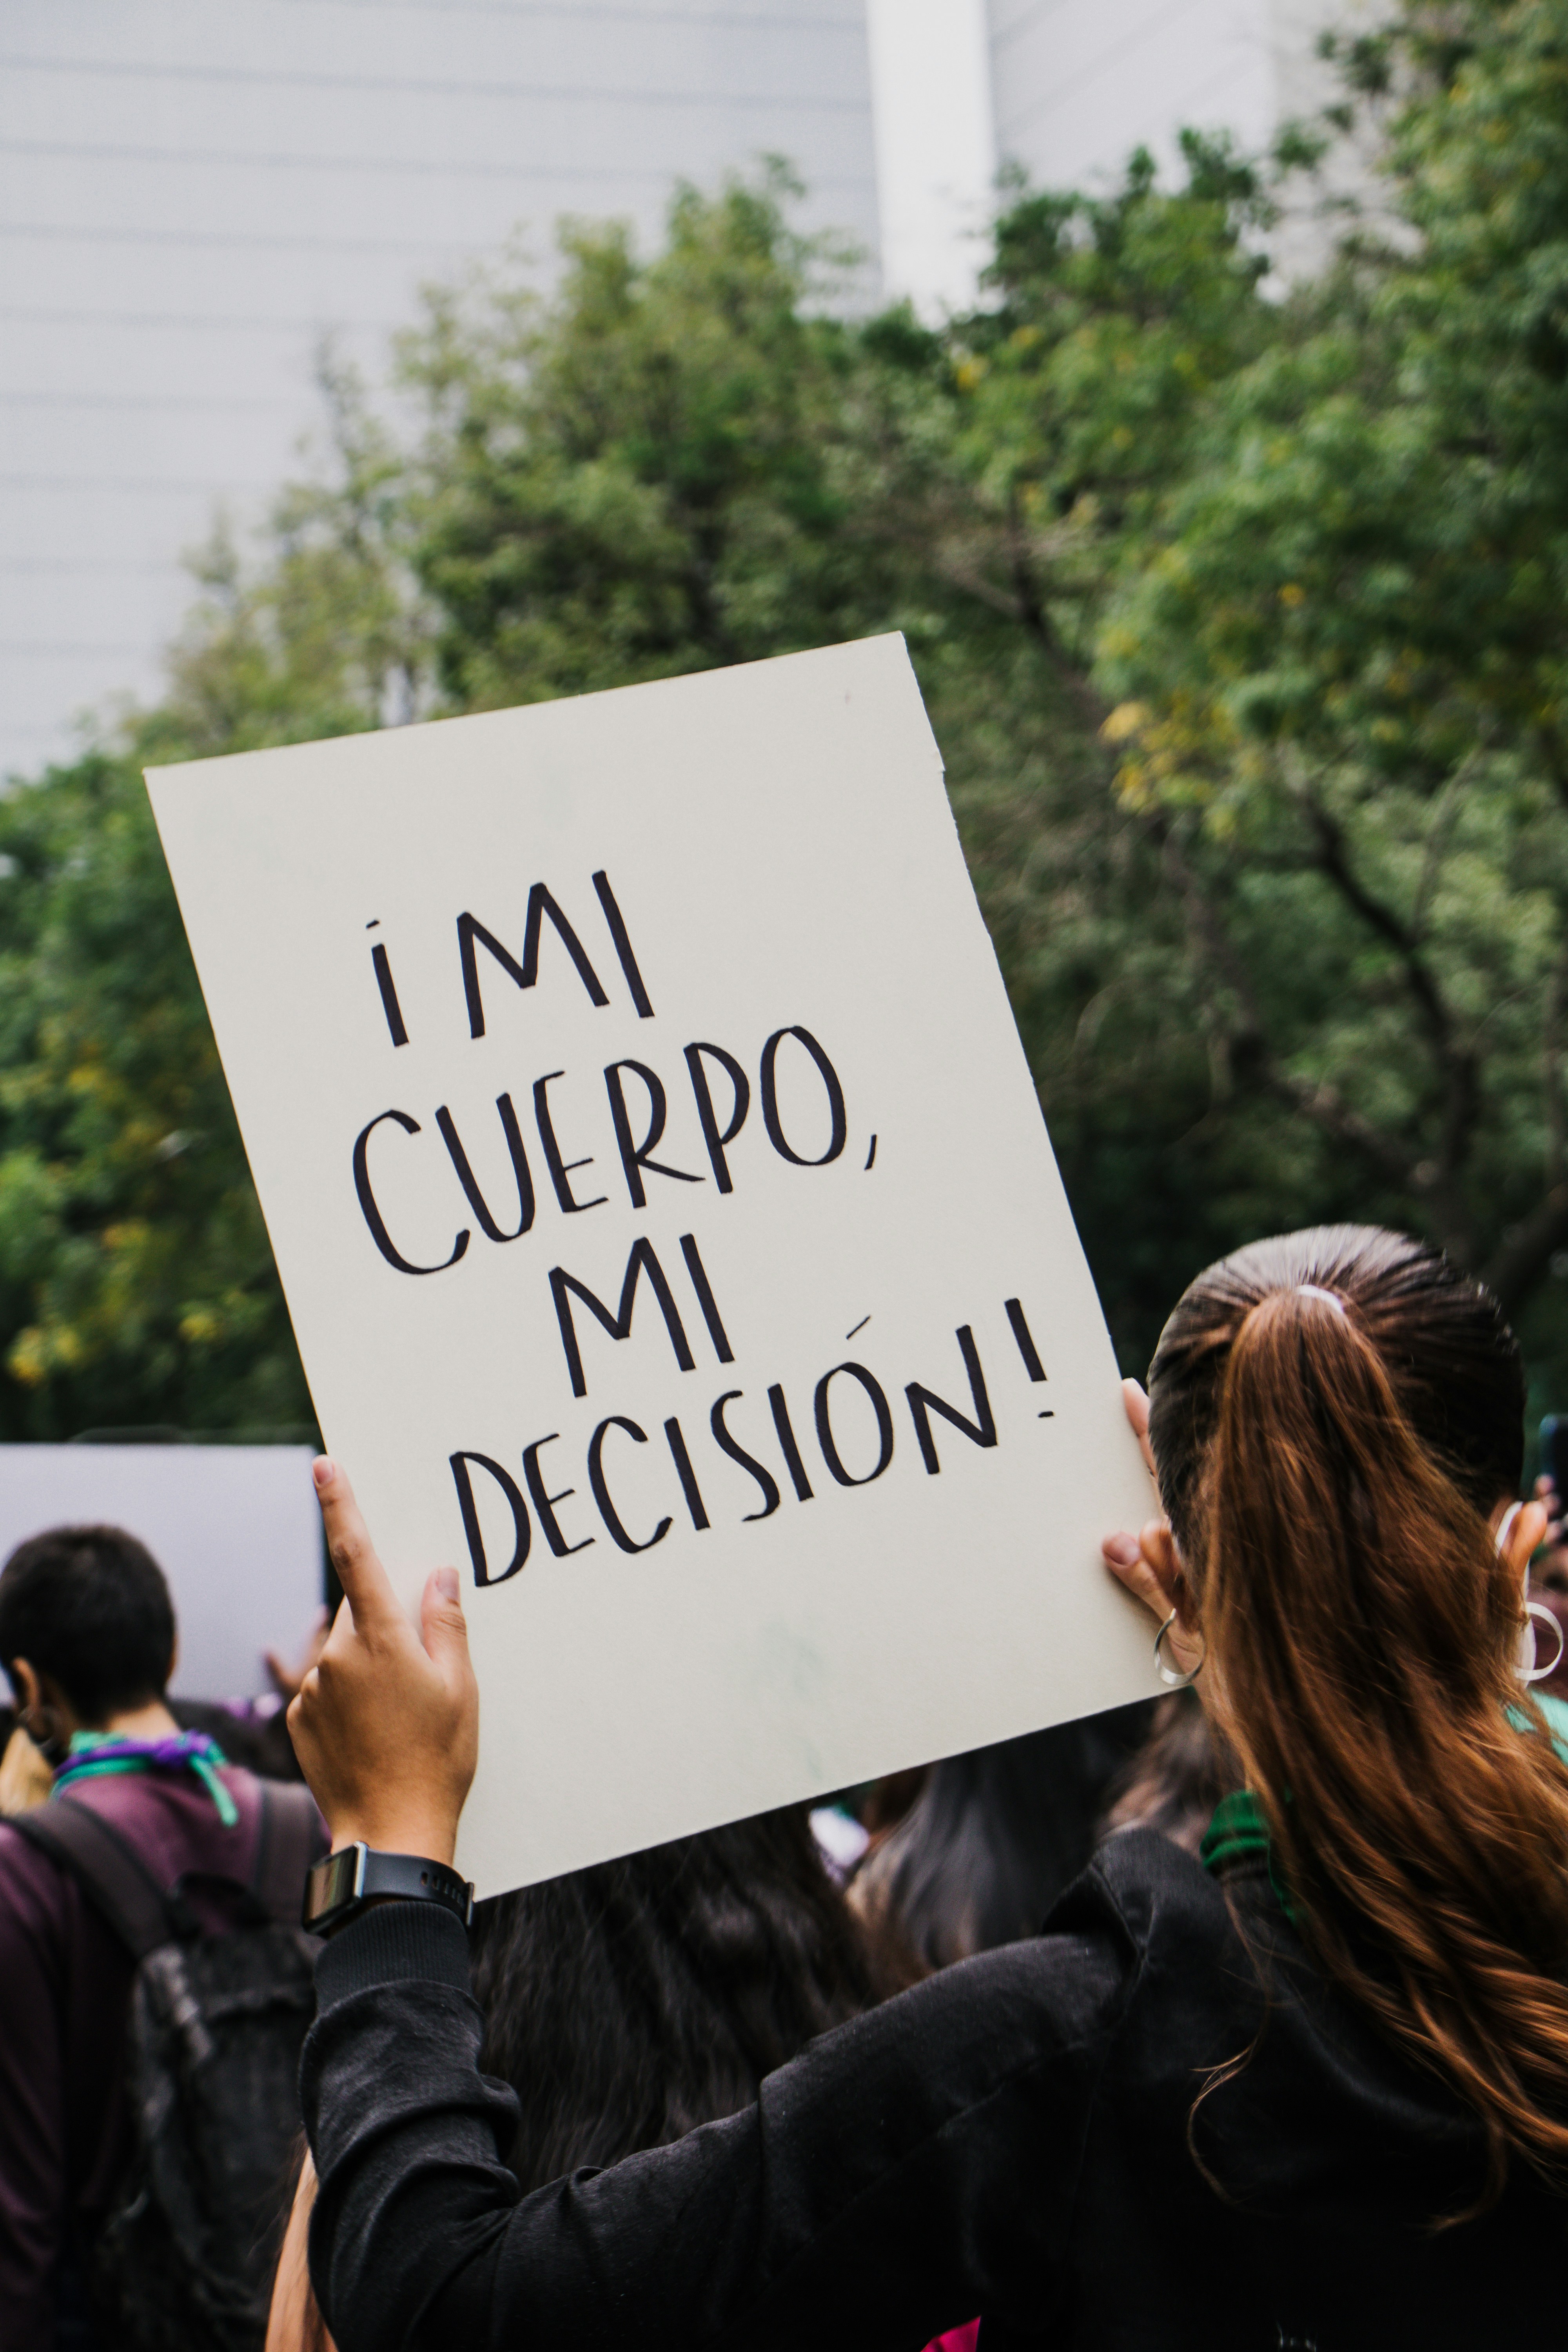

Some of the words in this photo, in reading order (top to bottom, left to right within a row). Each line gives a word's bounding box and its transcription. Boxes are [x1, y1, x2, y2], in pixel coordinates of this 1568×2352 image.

[352, 1025, 878, 1276] CUERPO,
[548, 1233, 735, 1399] MI
[448, 1298, 1055, 1587] DECISIÓN!
